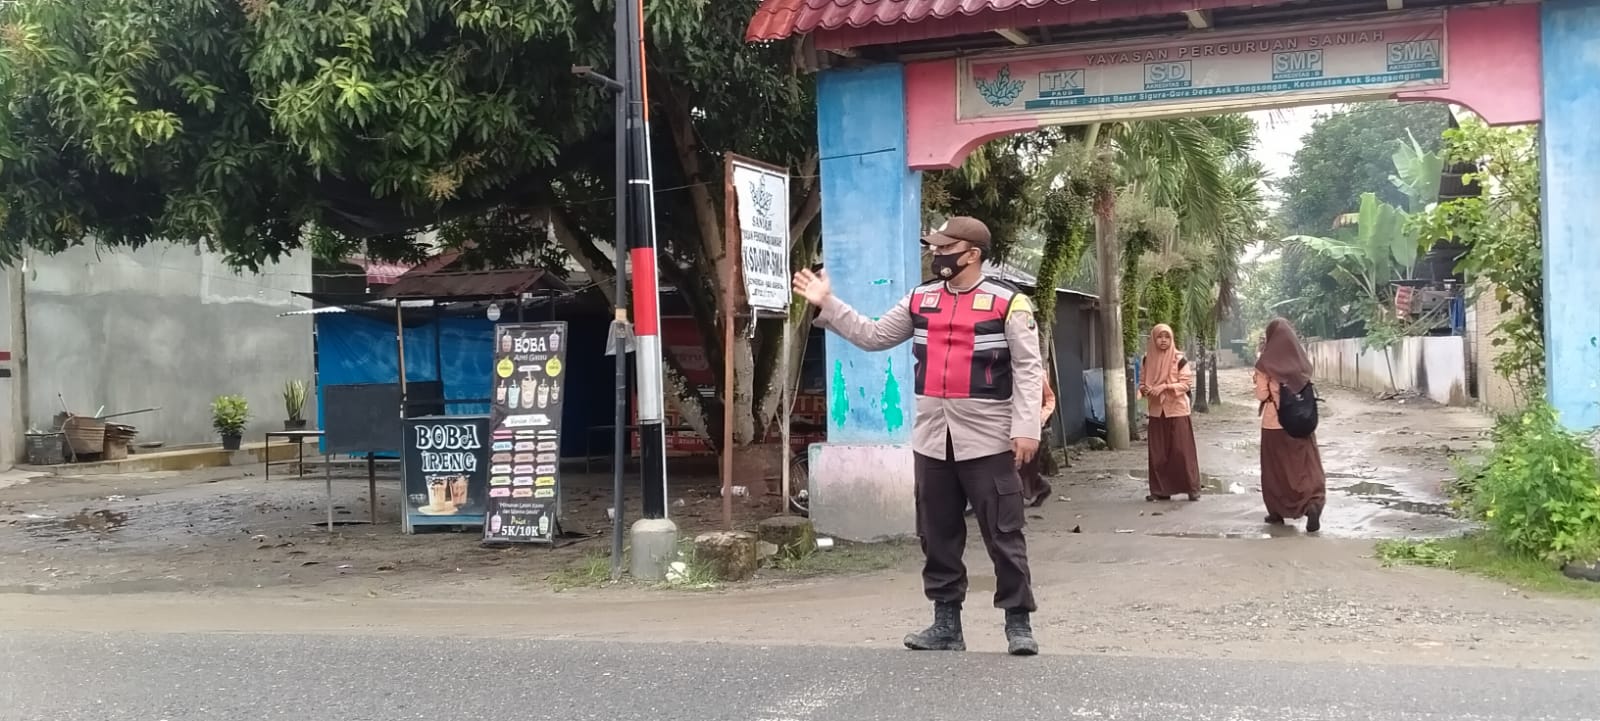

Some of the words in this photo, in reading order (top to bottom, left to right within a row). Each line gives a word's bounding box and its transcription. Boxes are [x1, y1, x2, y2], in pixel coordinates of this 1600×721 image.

[1086, 49, 1168, 65] YAYASAN
[1178, 39, 1298, 58] PERGURUAN
[1310, 31, 1385, 47] SANIAH
[1389, 41, 1437, 63] SMA
[1275, 52, 1321, 72] SMP
[1045, 71, 1079, 90] TK
[1150, 63, 1186, 81] SD
[1049, 98, 1078, 106] Alamat
[1113, 95, 1137, 103] Besar
[1140, 90, 1189, 100] Sigura-Gura
[1191, 88, 1213, 96] Desa
[1293, 78, 1342, 88] Kecamatan
[1344, 76, 1361, 85] Aek
[752, 216, 772, 231] SANIAH
[513, 336, 547, 353] BOBA
[414, 425, 481, 449] BOBA
[501, 525, 539, 536] 5K/10K
